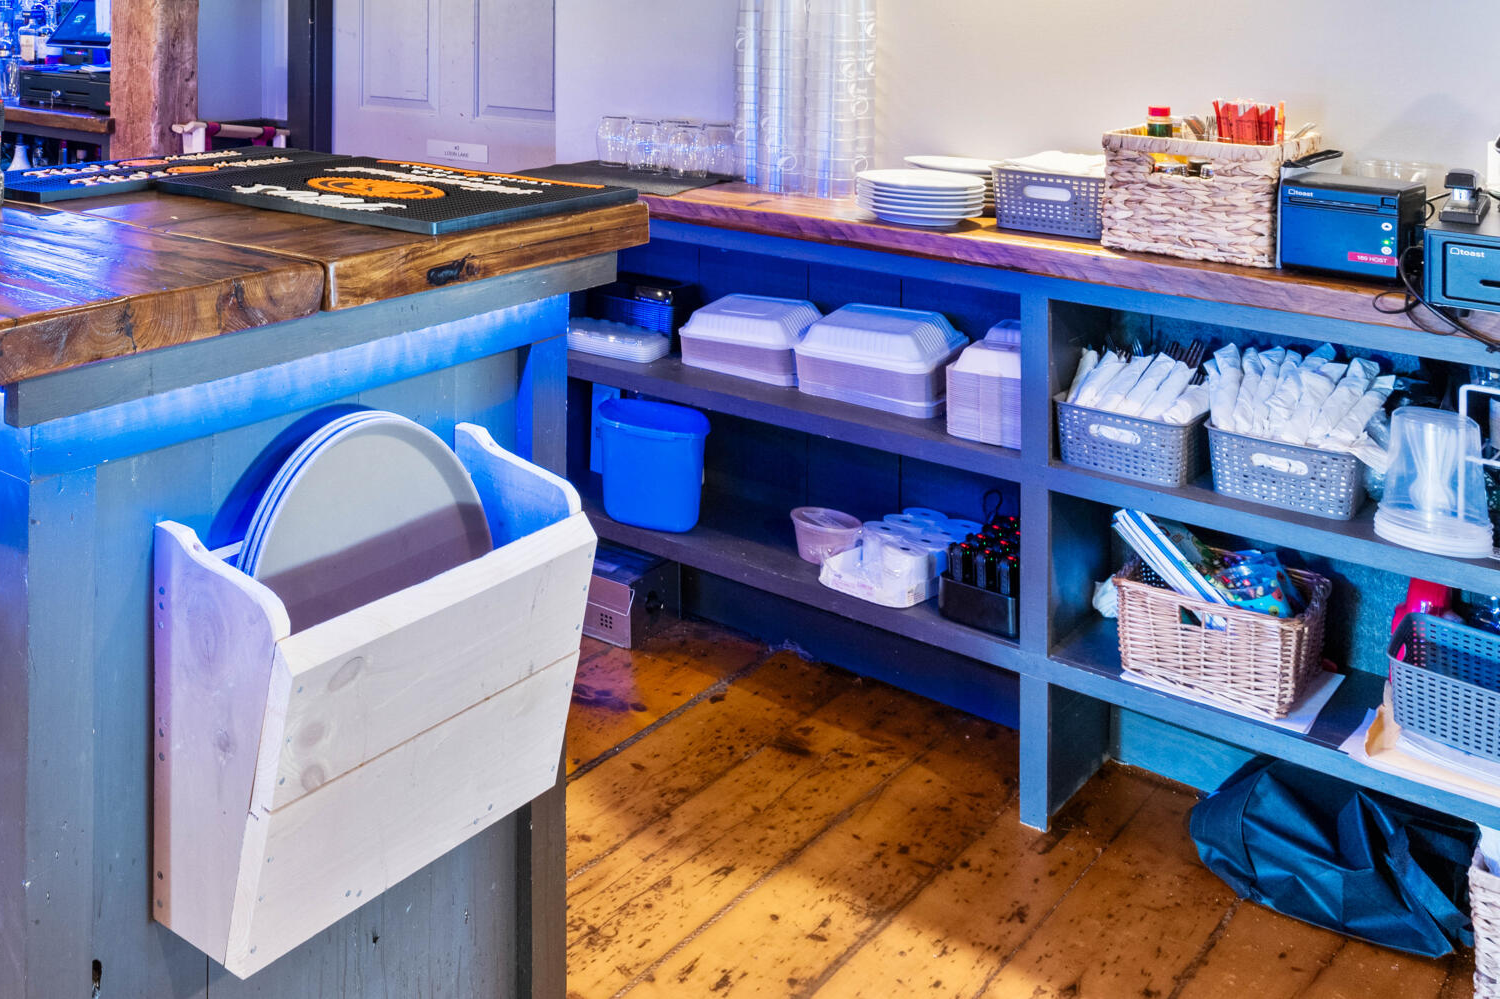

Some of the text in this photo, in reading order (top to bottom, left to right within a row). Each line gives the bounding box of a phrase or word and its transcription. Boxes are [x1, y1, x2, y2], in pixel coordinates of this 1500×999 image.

[1295, 189, 1314, 198] toast
[1460, 249, 1485, 258] toast
[1369, 256, 1388, 264] HOST
